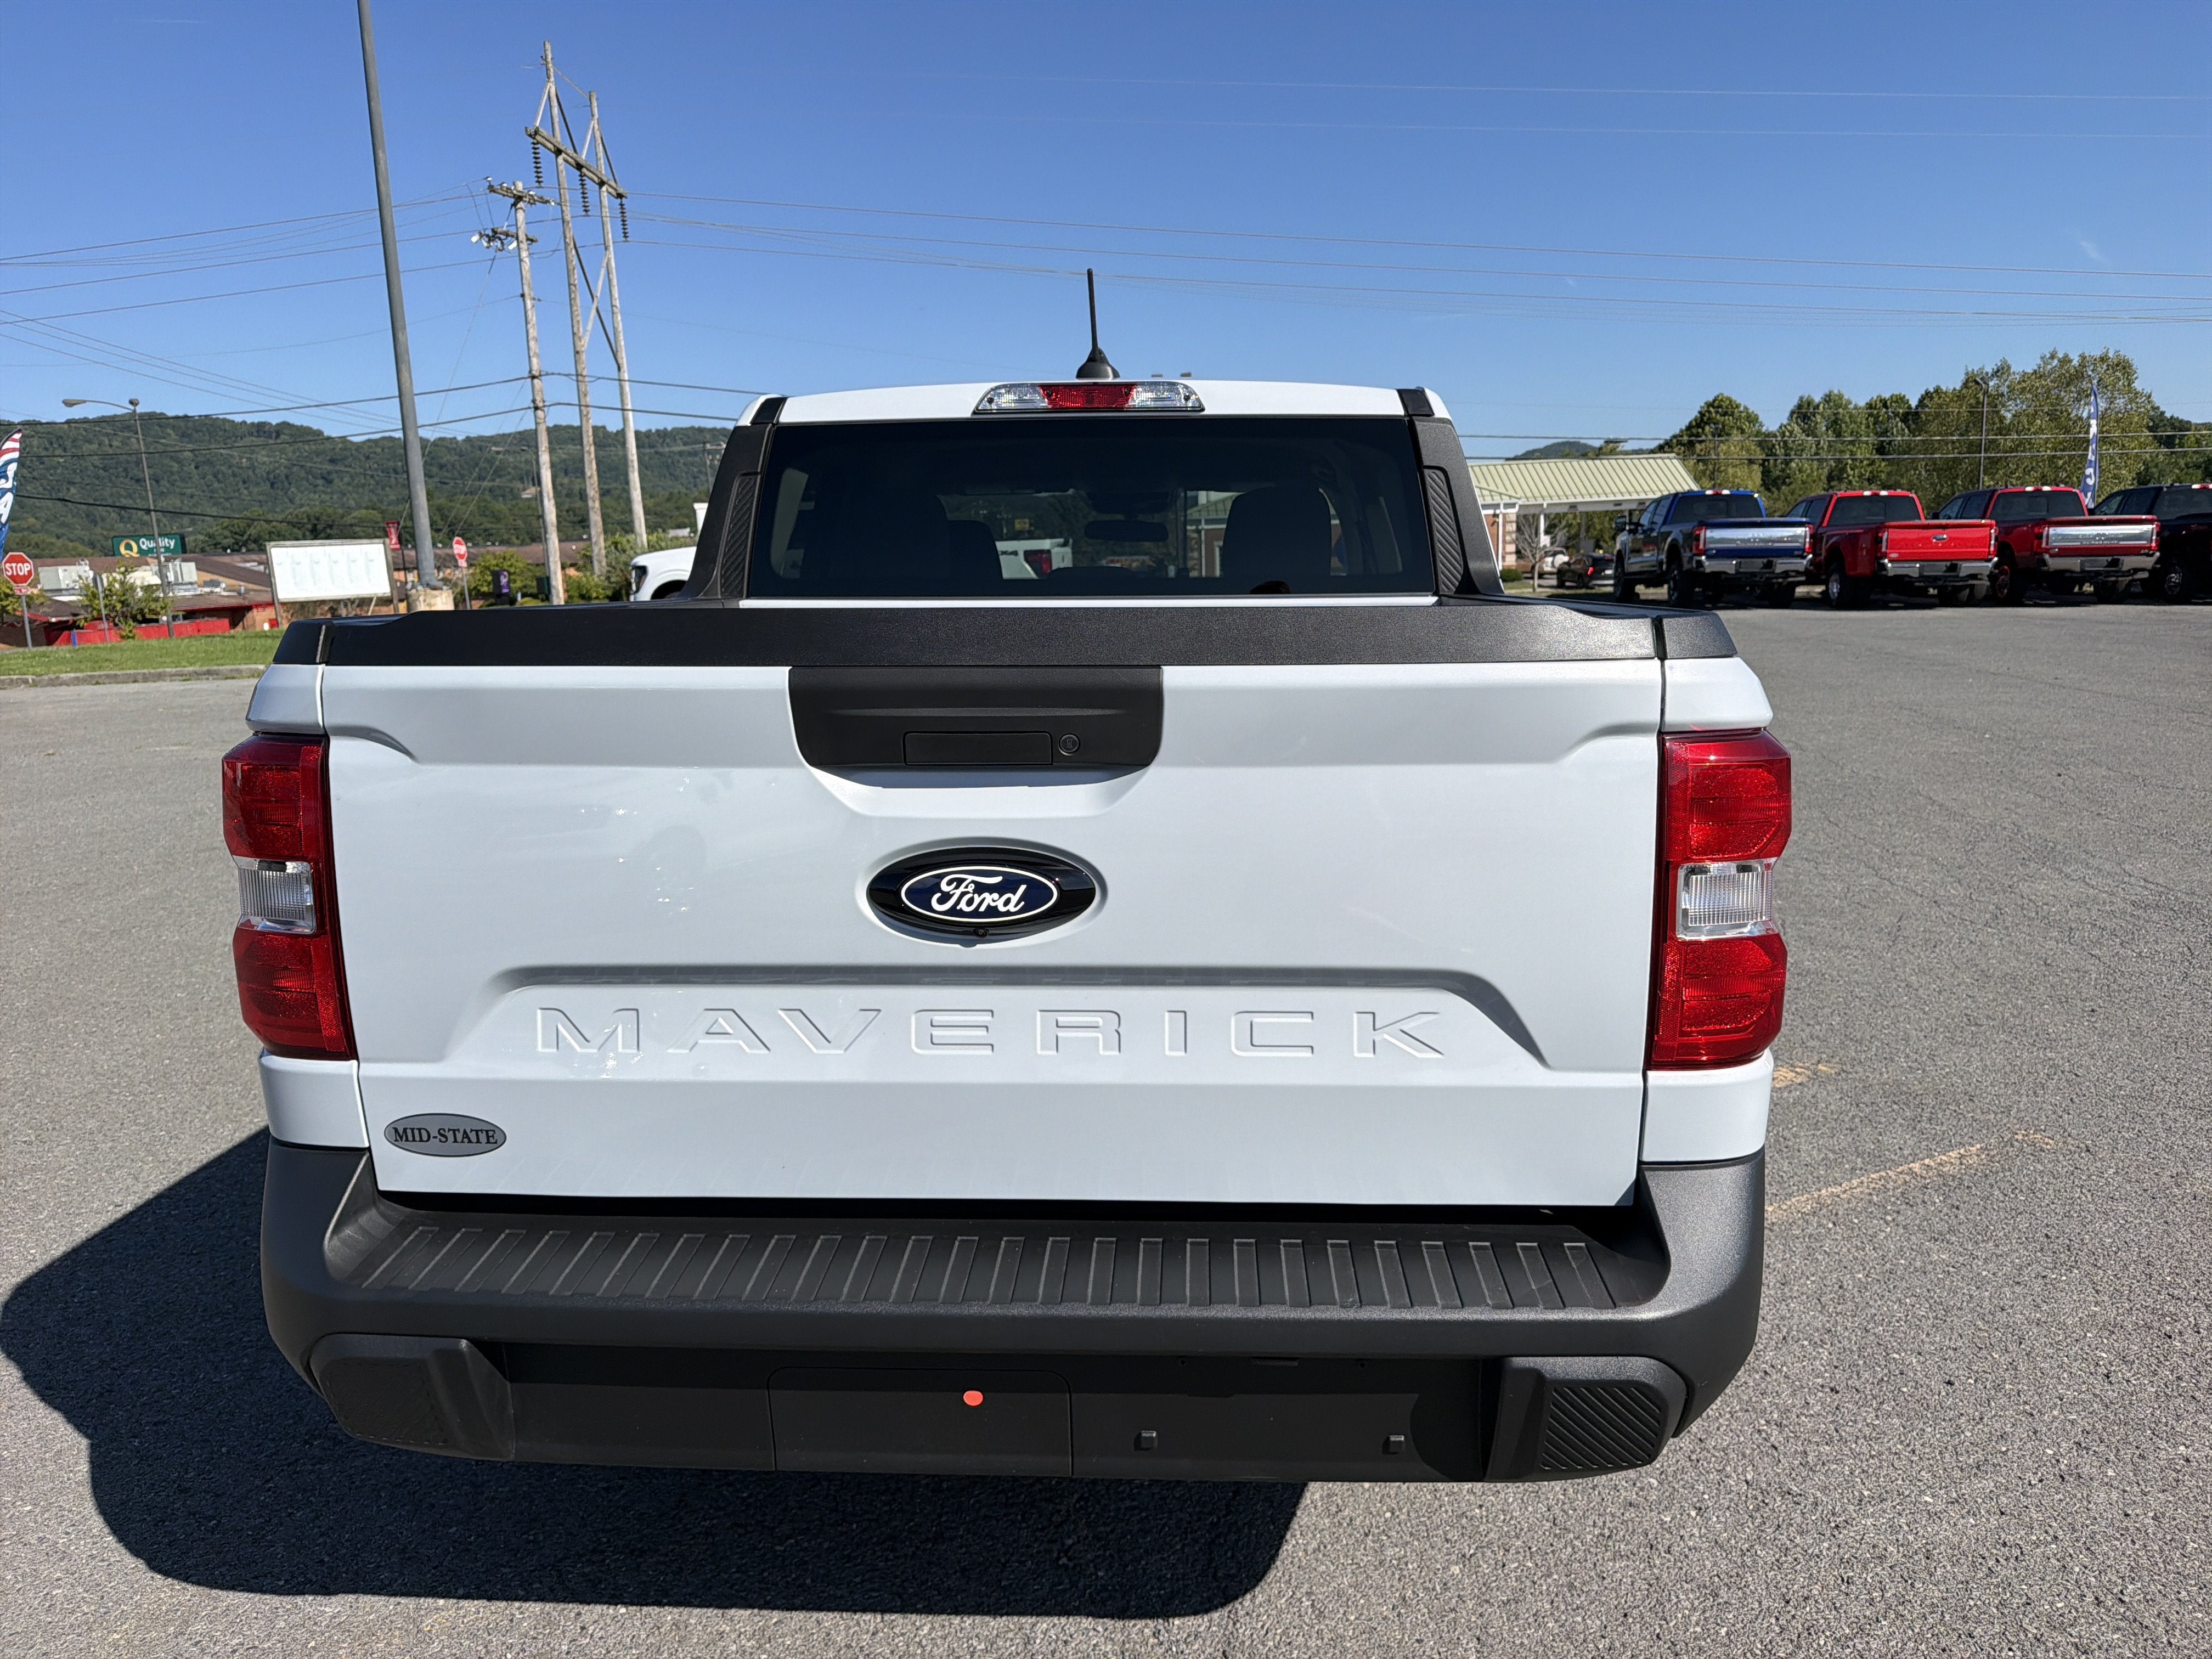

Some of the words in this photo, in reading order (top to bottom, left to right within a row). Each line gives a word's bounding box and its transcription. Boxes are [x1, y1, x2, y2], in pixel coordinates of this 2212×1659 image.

[5, 562, 31, 576] STOP
[931, 873, 1027, 912] Ford
[536, 1007, 1445, 1058] MAVERICK
[392, 1126, 498, 1144] MID-STATE
